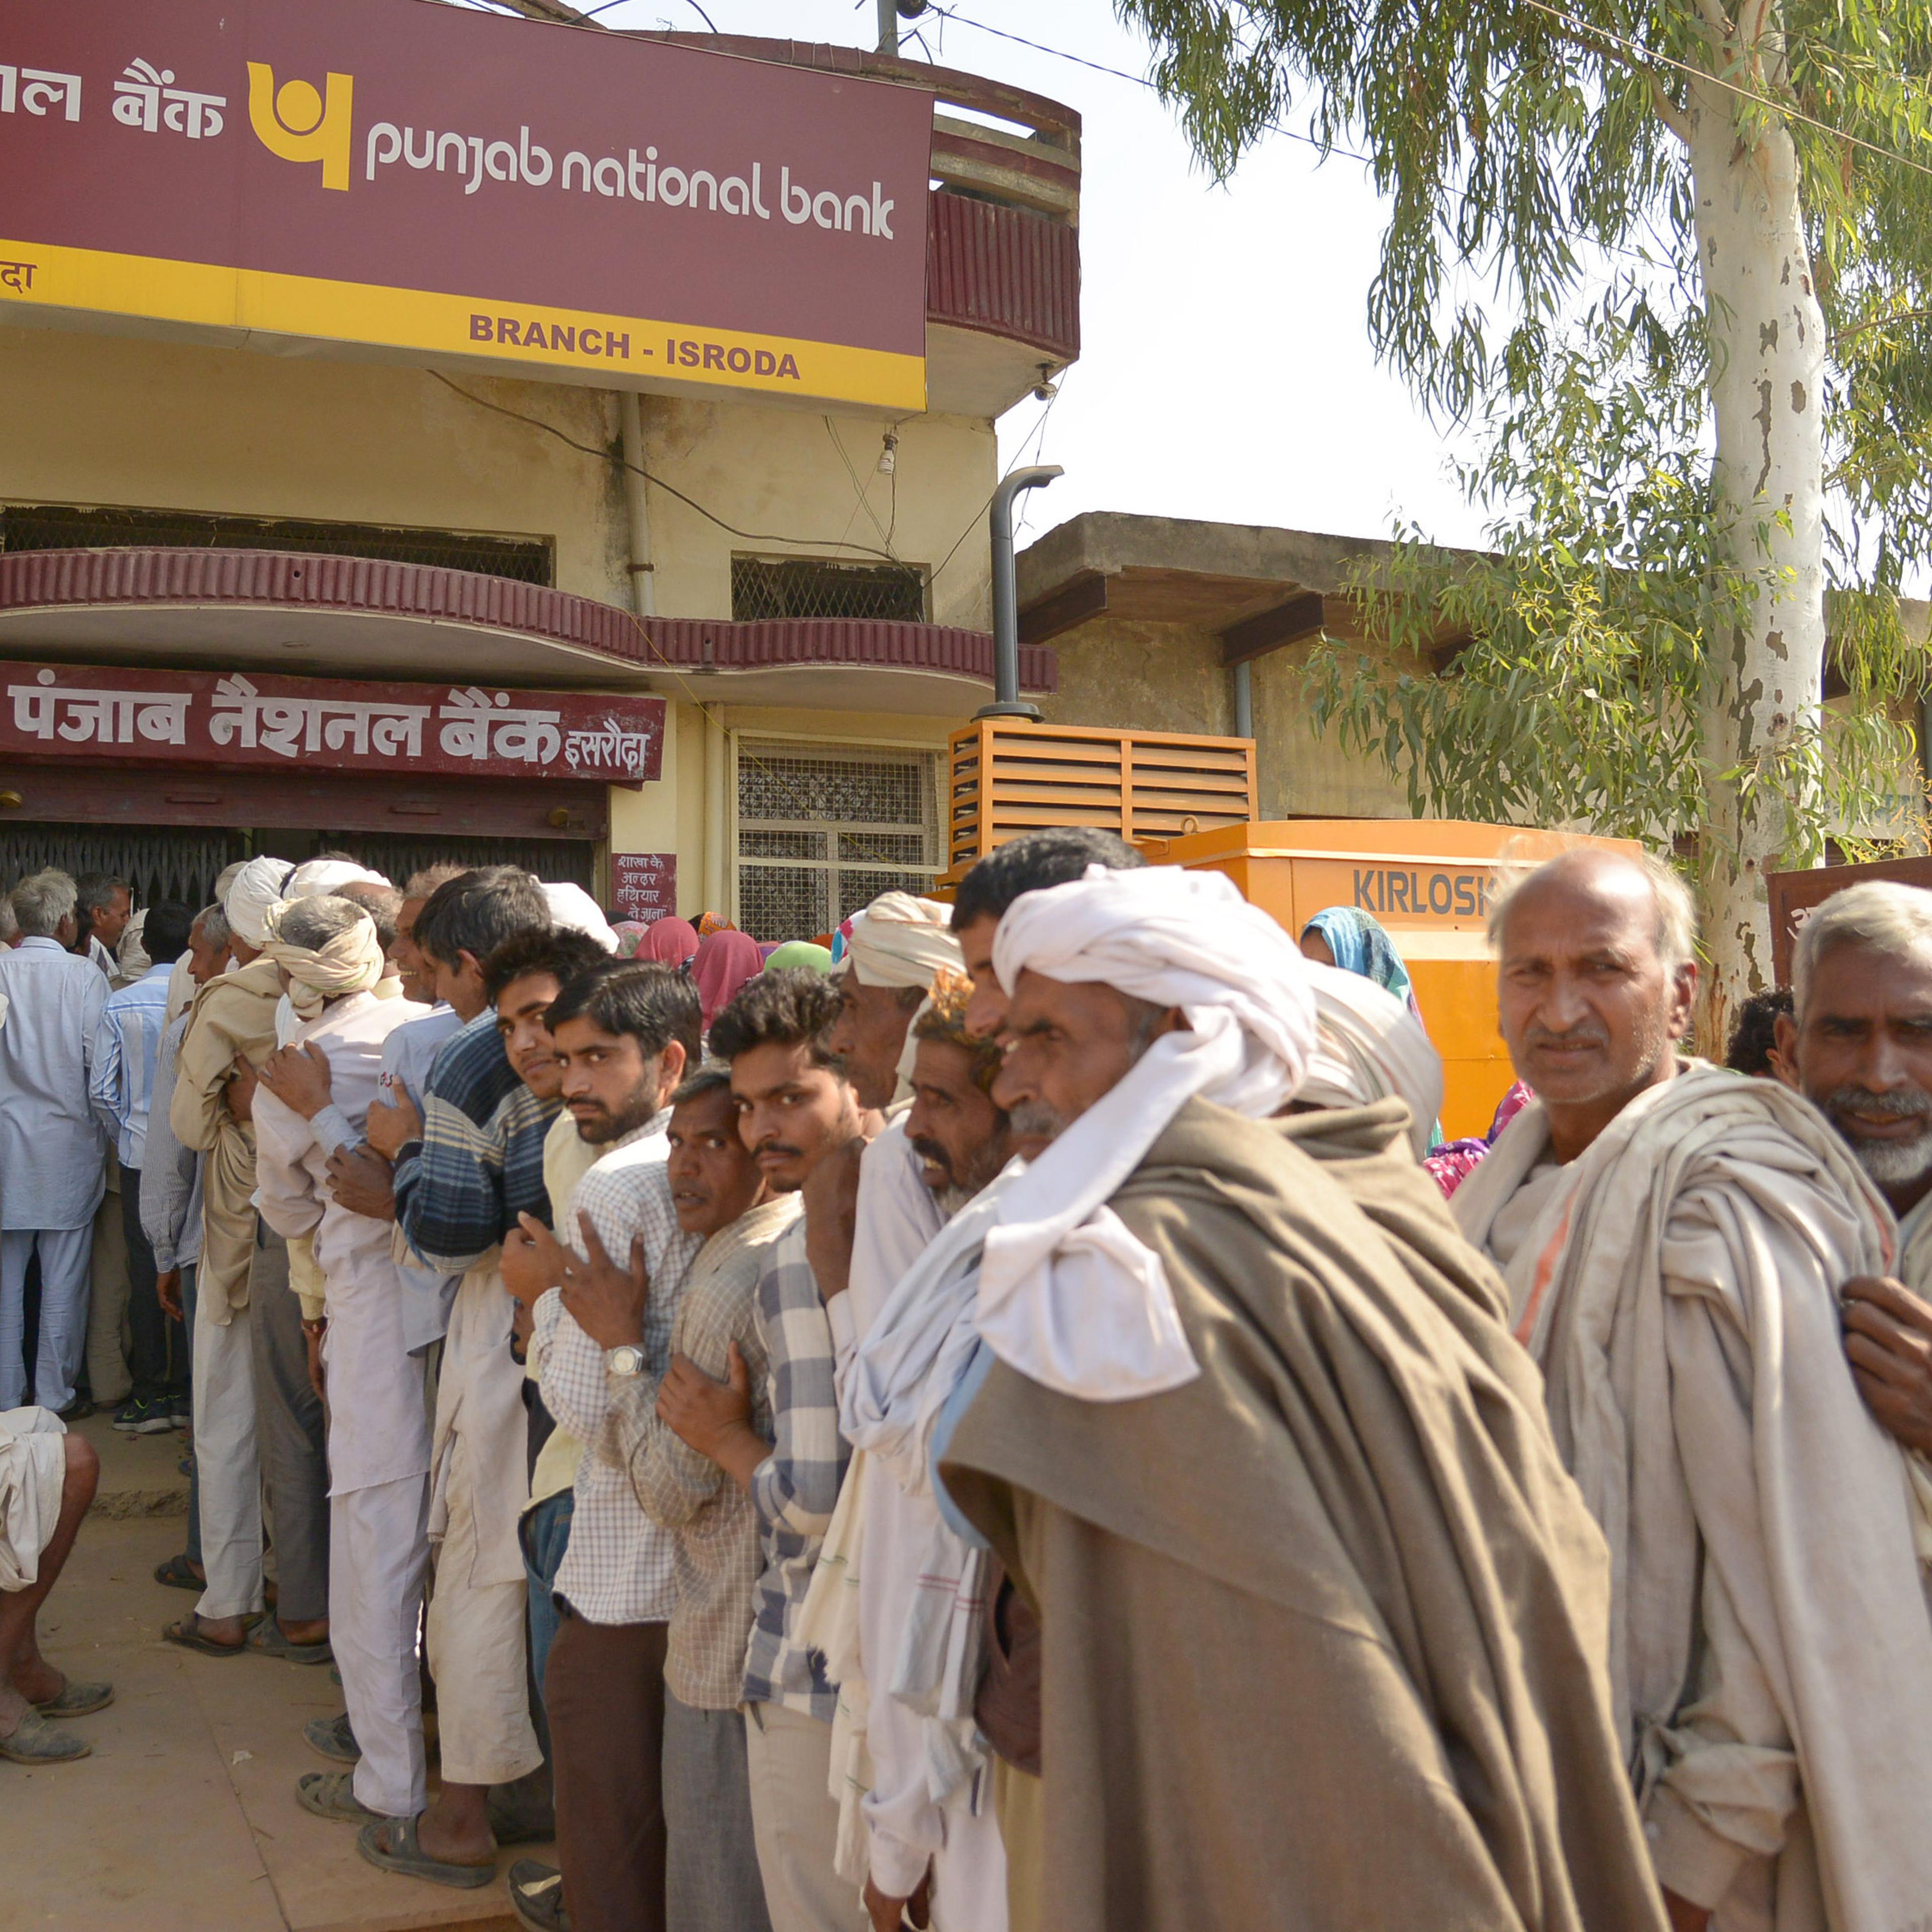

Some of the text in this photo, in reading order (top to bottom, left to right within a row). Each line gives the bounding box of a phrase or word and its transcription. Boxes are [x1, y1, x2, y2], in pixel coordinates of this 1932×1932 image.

[112, 57, 226, 139] बैंक
[366, 122, 894, 240] punjab national bank
[469, 314, 630, 359] BRANCH
[667, 339, 801, 380] ISRODA
[8, 669, 192, 745] पंजाब
[209, 673, 431, 758] नैशनल
[439, 687, 561, 765] बैंक
[617, 884, 660, 904] हथियार
[618, 854, 664, 868] शाखा के
